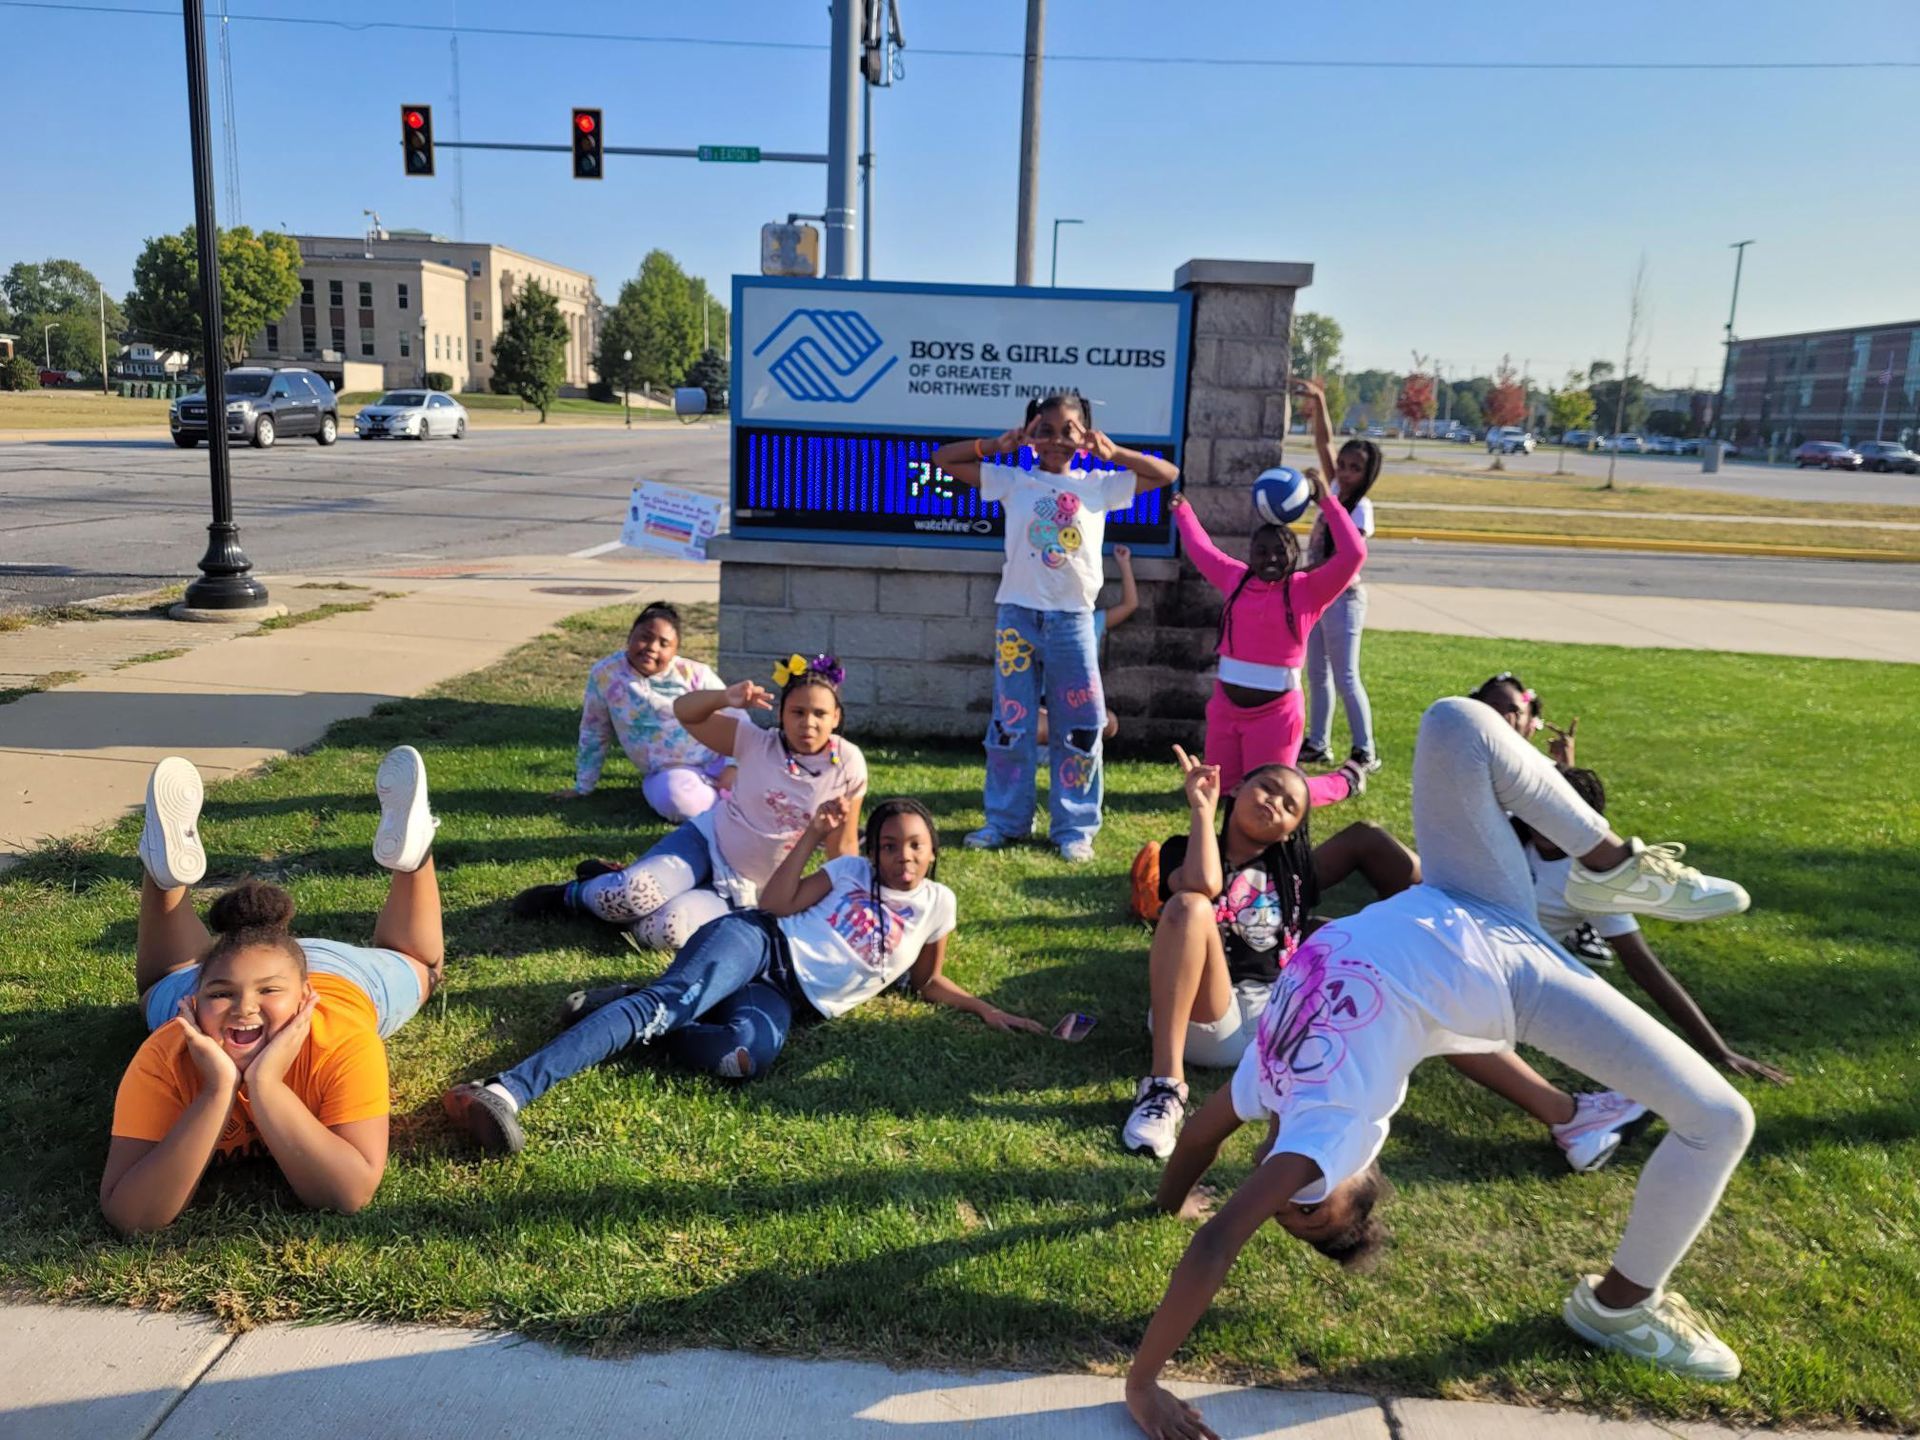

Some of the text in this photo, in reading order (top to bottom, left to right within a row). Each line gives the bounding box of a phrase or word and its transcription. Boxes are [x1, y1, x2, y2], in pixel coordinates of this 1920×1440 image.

[910, 341, 1165, 368] BOYS & GIRLS CLUBS
[908, 363, 1013, 382] OF GREATER
[908, 381, 1011, 397] NORTHWEST
[914, 519, 970, 533] watchfire
